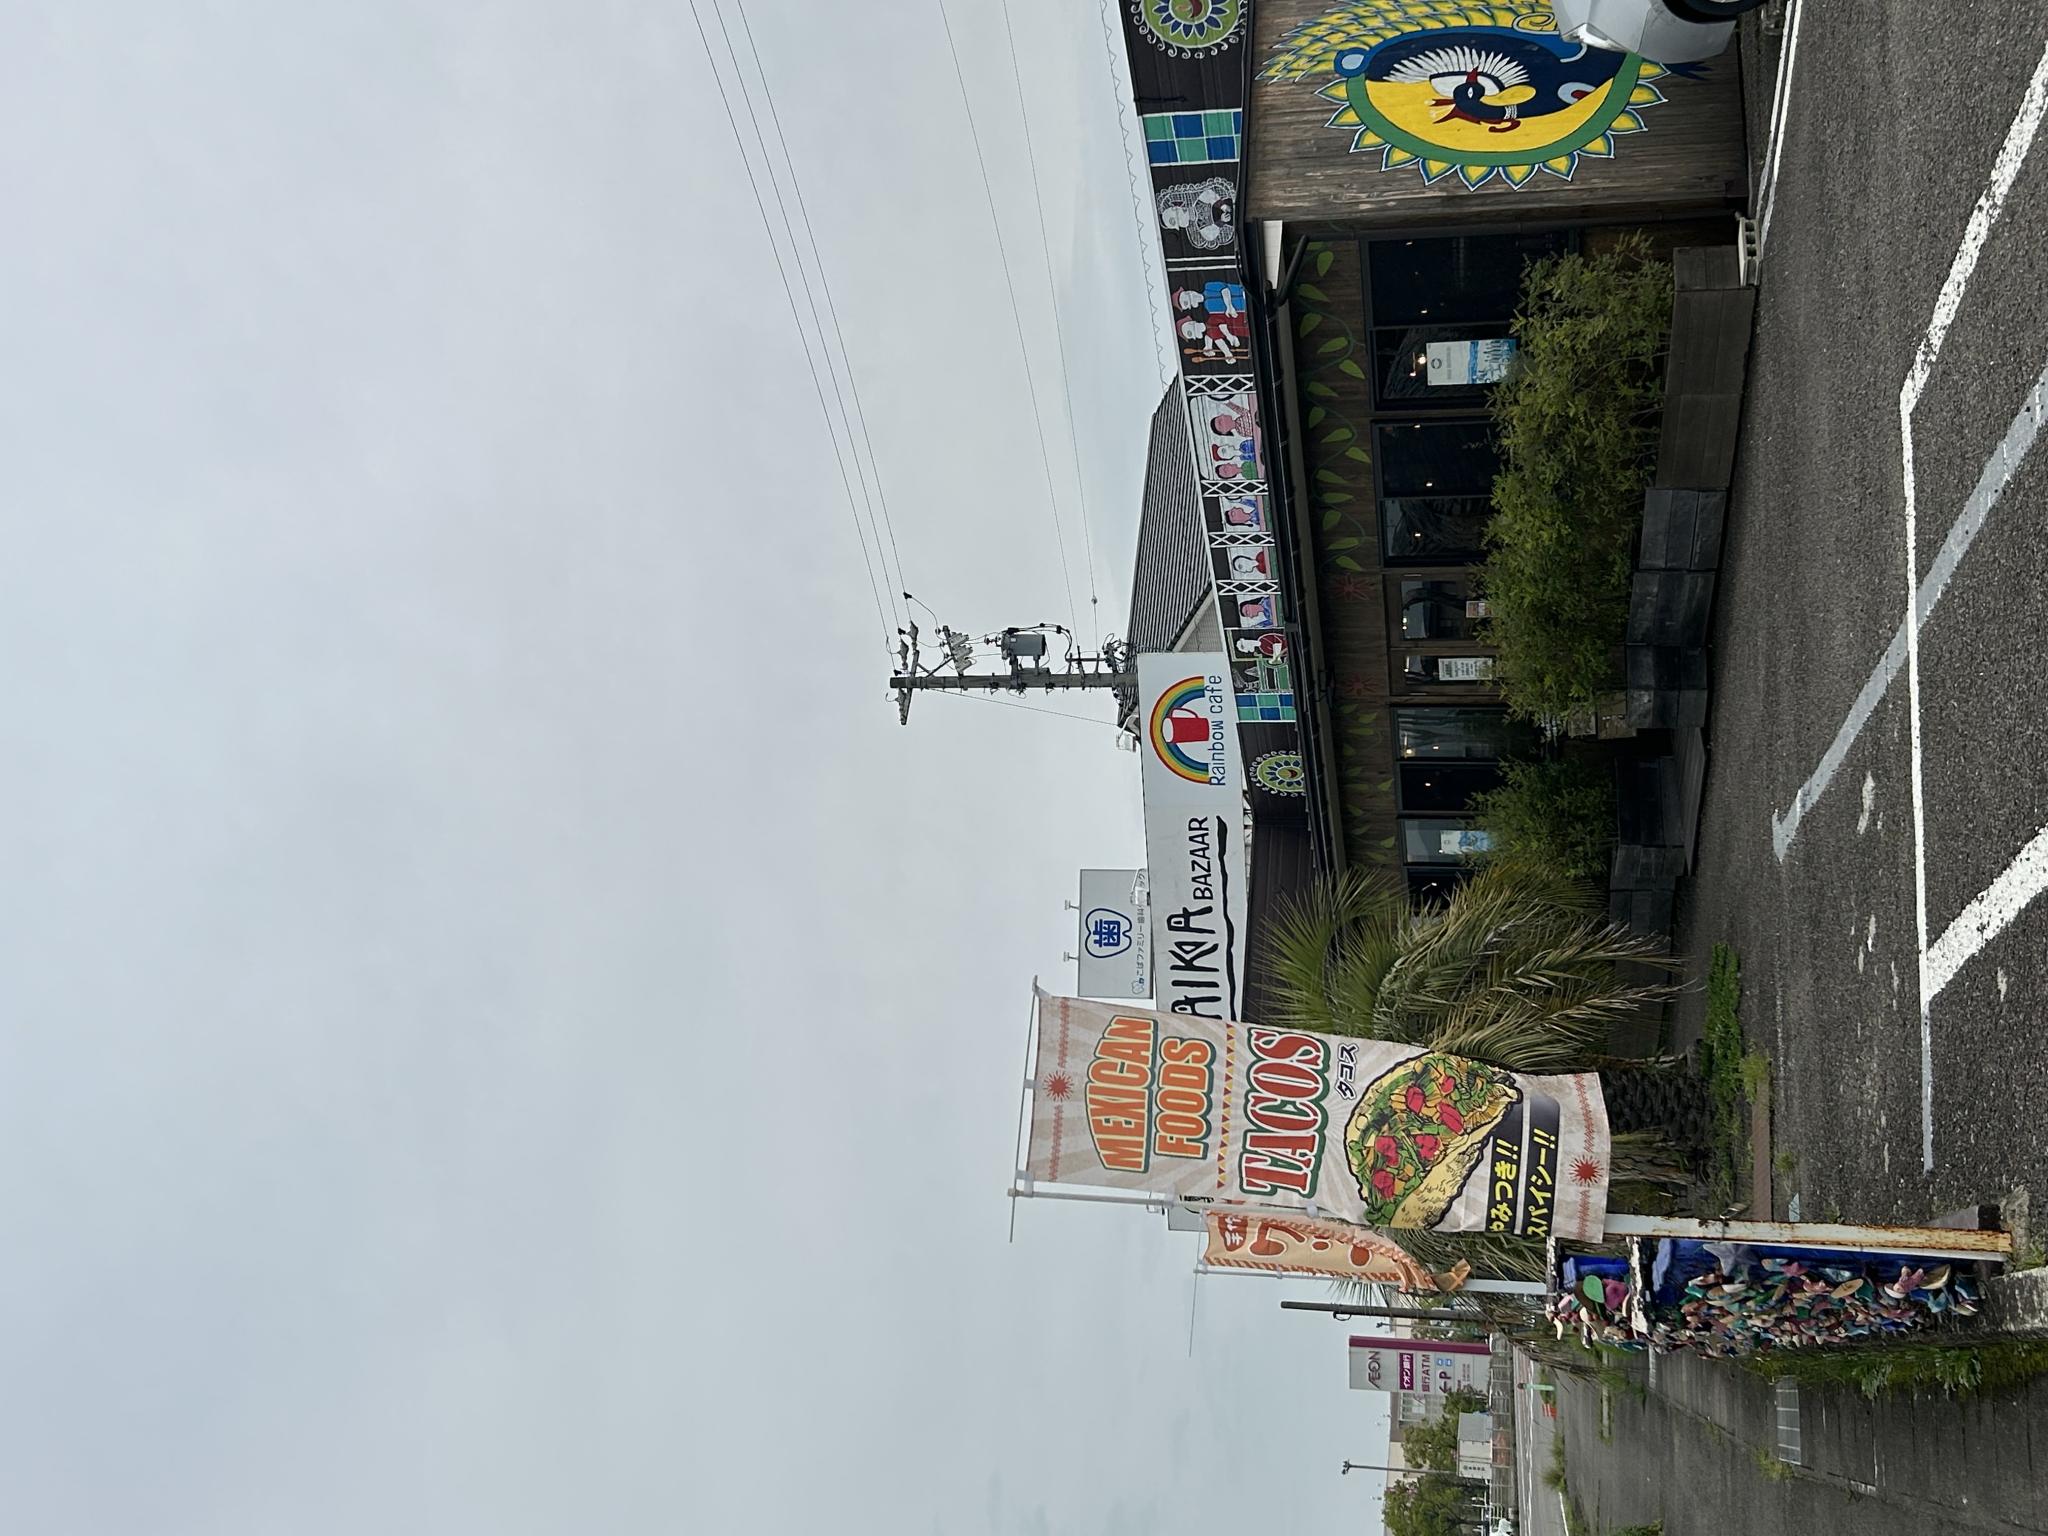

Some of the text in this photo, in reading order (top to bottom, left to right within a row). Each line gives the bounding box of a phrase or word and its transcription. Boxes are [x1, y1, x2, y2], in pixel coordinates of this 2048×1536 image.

[1203, 675, 1226, 786] Rainbow cafe
[1188, 816, 1213, 900] BAZAAR
[1092, 919, 1121, 948] 歯
[1085, 1015, 1156, 1172] MEXICAN
[1155, 1037, 1213, 1158] FOODS
[1240, 1028, 1328, 1196] TACOS
[1336, 1043, 1358, 1099] タコス
[1402, 1354, 1412, 1388] イオン銀行
[1438, 1370, 1452, 1380] P
